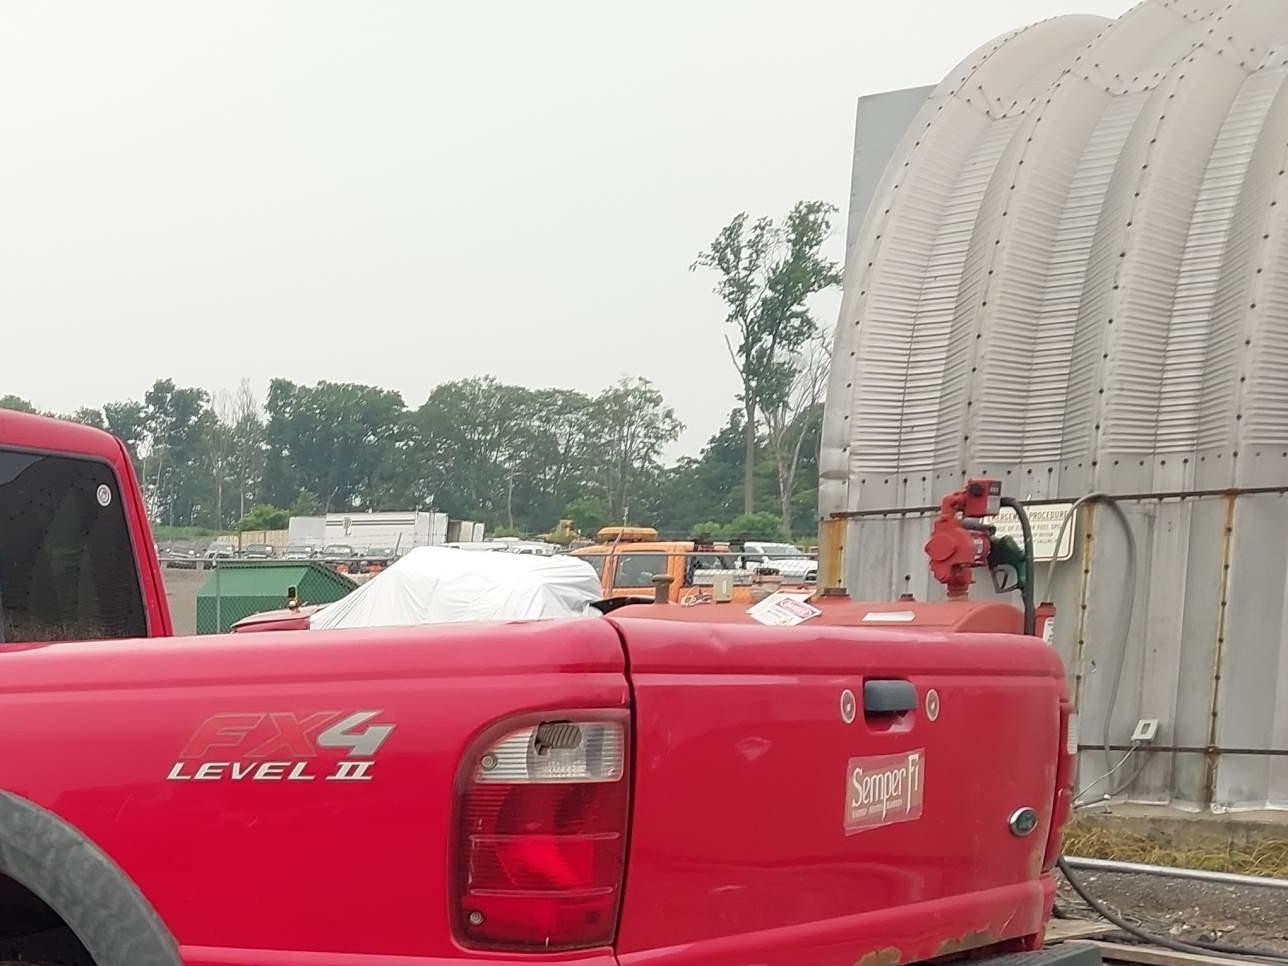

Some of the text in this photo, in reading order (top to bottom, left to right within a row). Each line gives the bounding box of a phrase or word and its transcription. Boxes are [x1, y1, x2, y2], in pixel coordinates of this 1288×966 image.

[178, 709, 396, 758] FX4
[167, 761, 376, 780] LEVEL II
[851, 753, 920, 822] Semper Fi
